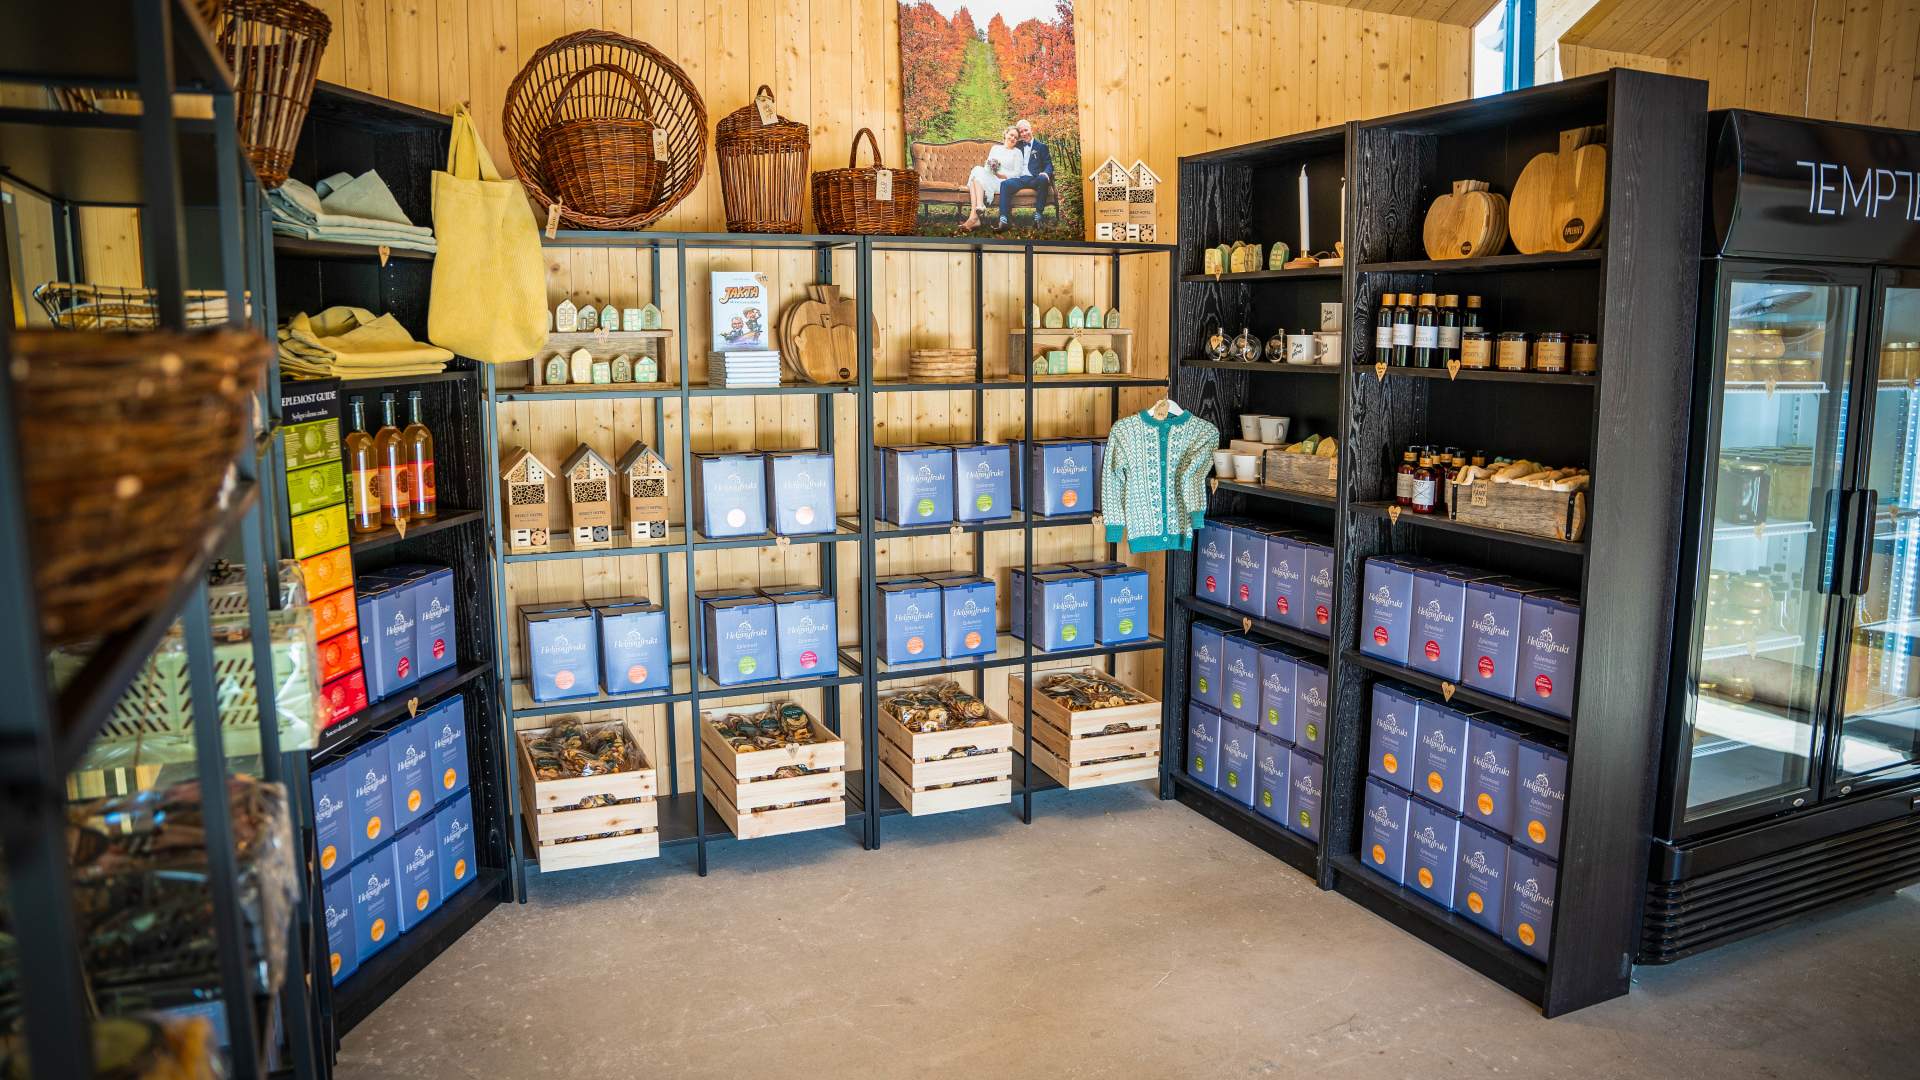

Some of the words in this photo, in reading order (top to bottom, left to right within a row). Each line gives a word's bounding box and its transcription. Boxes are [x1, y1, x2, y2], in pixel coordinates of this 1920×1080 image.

[719, 286, 760, 304] JAKTA
[281, 393, 316, 407] EPLEMOST
[316, 391, 337, 401] GUIDE
